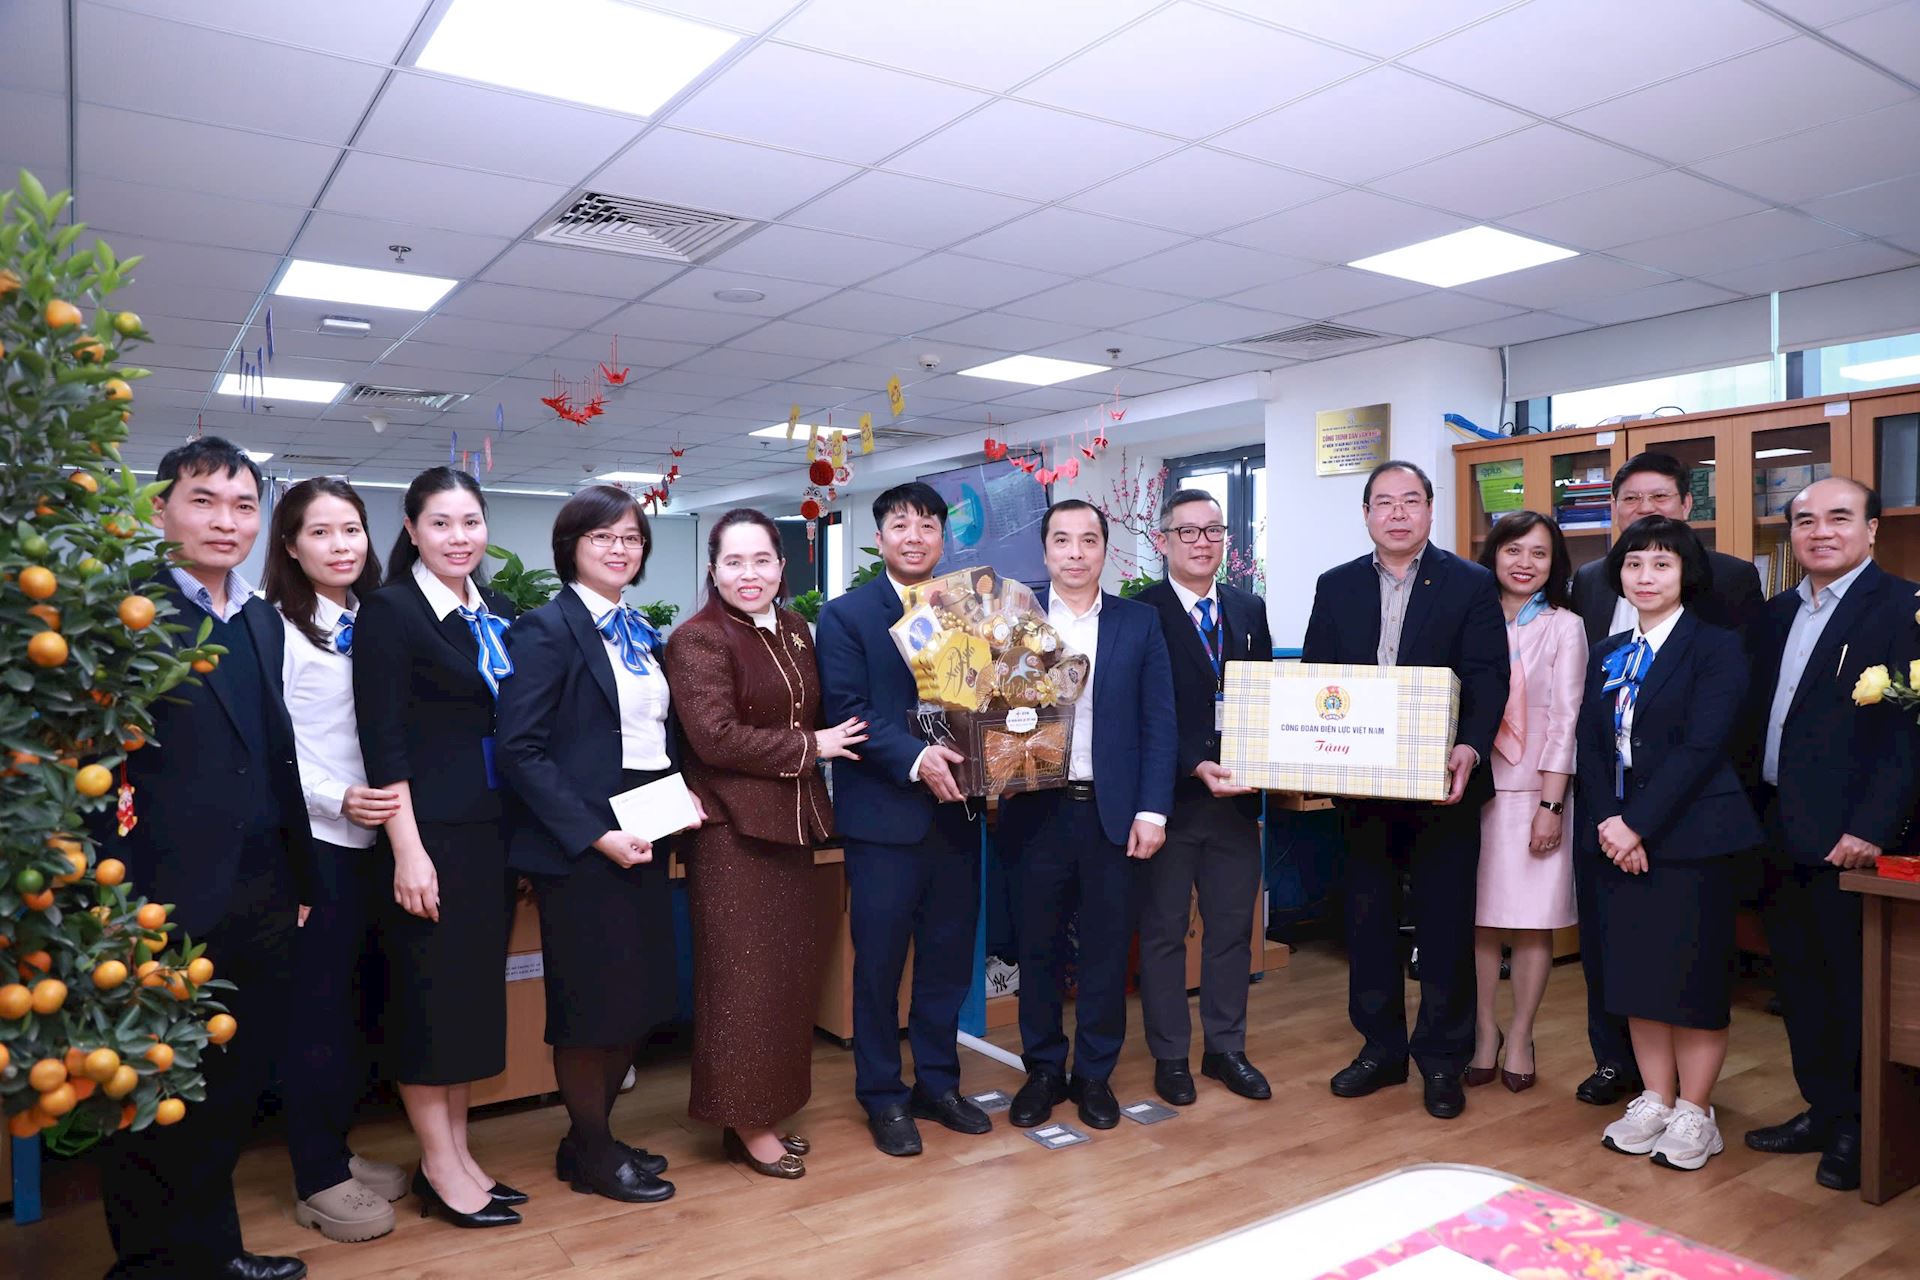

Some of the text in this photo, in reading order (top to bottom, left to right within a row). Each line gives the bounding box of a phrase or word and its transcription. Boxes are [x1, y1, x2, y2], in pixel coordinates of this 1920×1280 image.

[1281, 723, 1385, 735] CÔNG ĐOÀN ĐIỆN LỰC VIỆT NAM
[1315, 739, 1350, 755] Tặng
